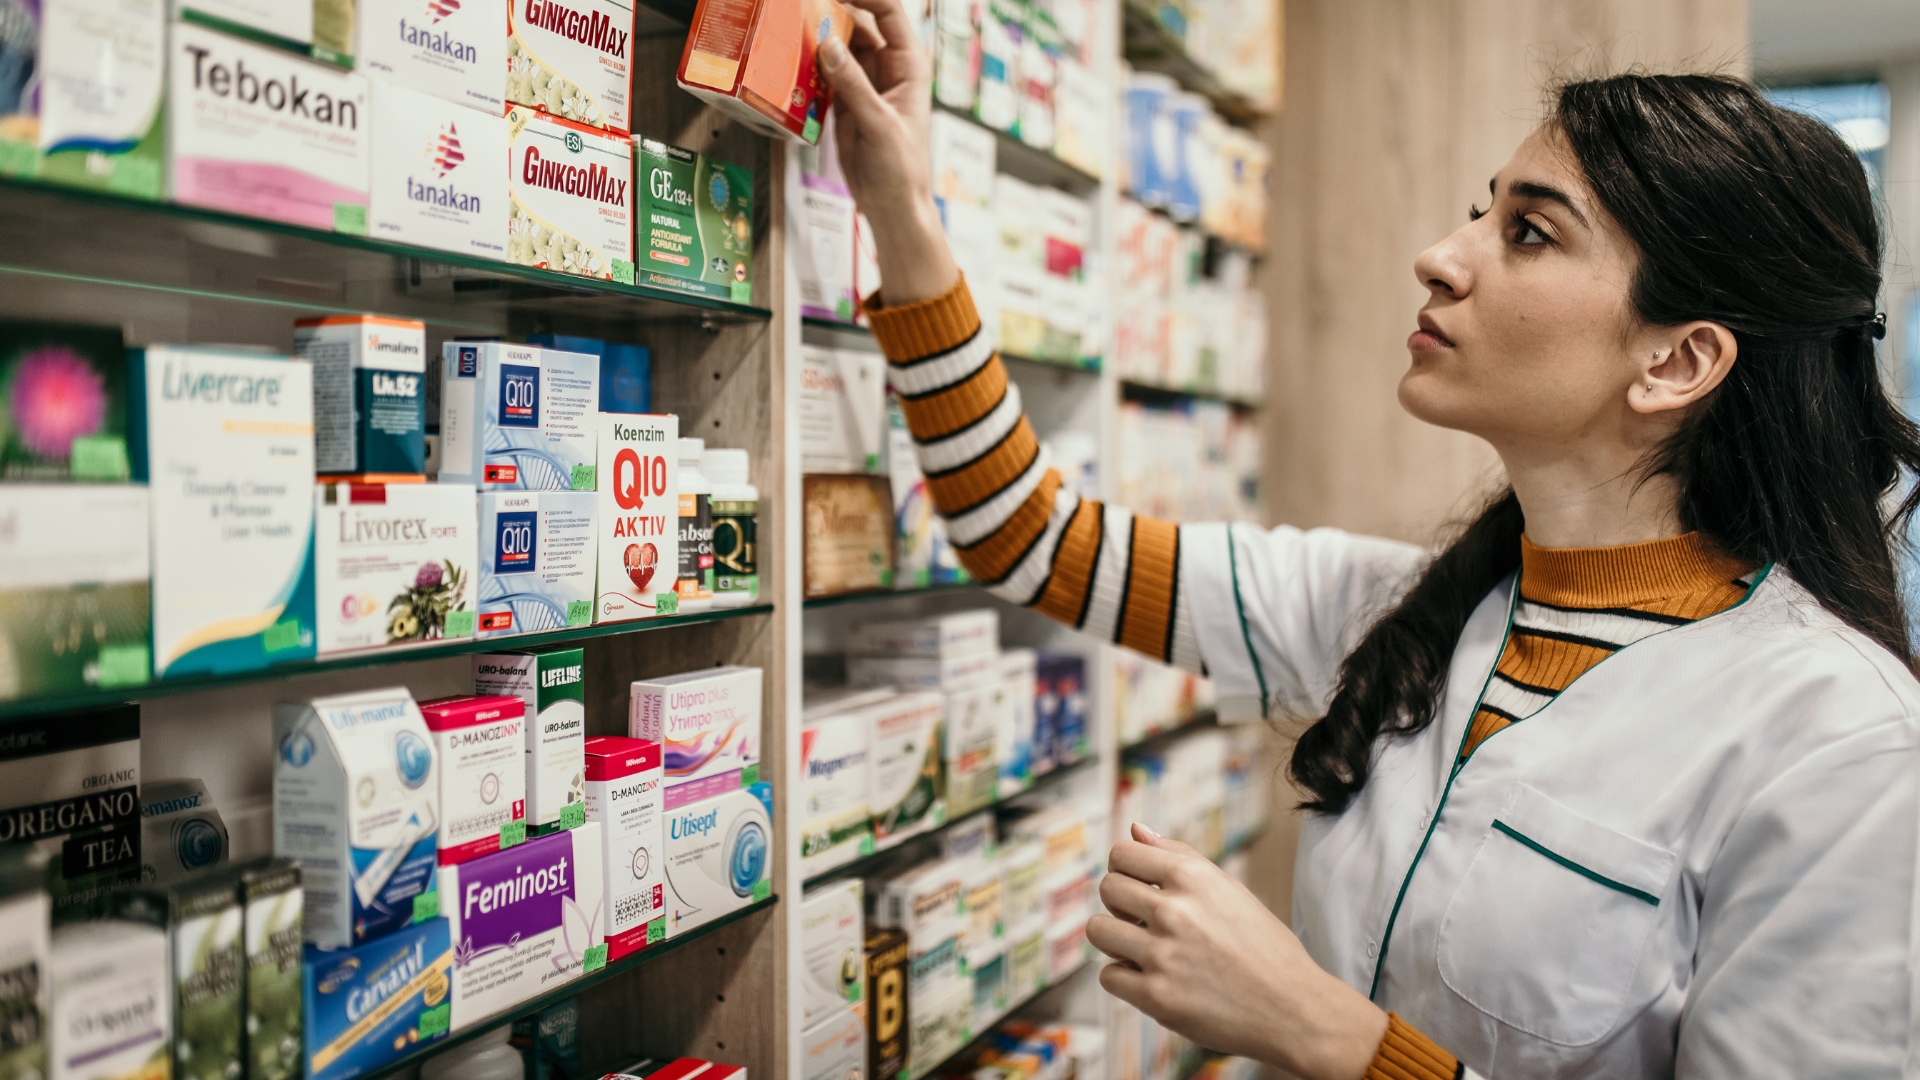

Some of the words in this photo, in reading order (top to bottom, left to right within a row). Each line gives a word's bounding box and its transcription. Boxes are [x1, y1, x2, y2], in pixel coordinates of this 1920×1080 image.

[399, 18, 477, 64] tanakan
[184, 45, 357, 130] Tebokan
[566, 134, 581, 151] ESI
[407, 176, 481, 214] tanakan
[651, 213, 681, 229] NATURAL
[650, 228, 692, 245] ANTIOXIDANT
[650, 238, 683, 252] FORMULA
[649, 273, 681, 287] Antioxidant
[161, 359, 281, 406] Livercare
[505, 380, 534, 408] Q10
[614, 423, 664, 441] Koenzim
[613, 448, 666, 511] Q10
[339, 509, 426, 543] Livorex
[430, 527, 457, 539] FORTE
[613, 516, 666, 538] AKTIV
[502, 527, 531, 554] Q10
[711, 518, 755, 573] Q1
[478, 664, 528, 676] URO-balans
[541, 665, 581, 688] LIFELINE
[651, 695, 661, 727] Utipro
[671, 691, 706, 710] Utipro
[641, 694, 652, 733] Утипро
[669, 712, 712, 733] Утипро
[450, 724, 519, 750] D-MANOZINN
[544, 720, 580, 734] URO-balans
[82, 768, 135, 789] ORGANIC
[611, 780, 657, 801] D-MANOZINN
[0, 791, 134, 841] OREGANO
[140, 794, 202, 818] emanoz
[671, 807, 717, 839] Utisept
[82, 836, 134, 868] TEA
[465, 857, 568, 920] Feminost
[570, 959, 584, 970] tablet
